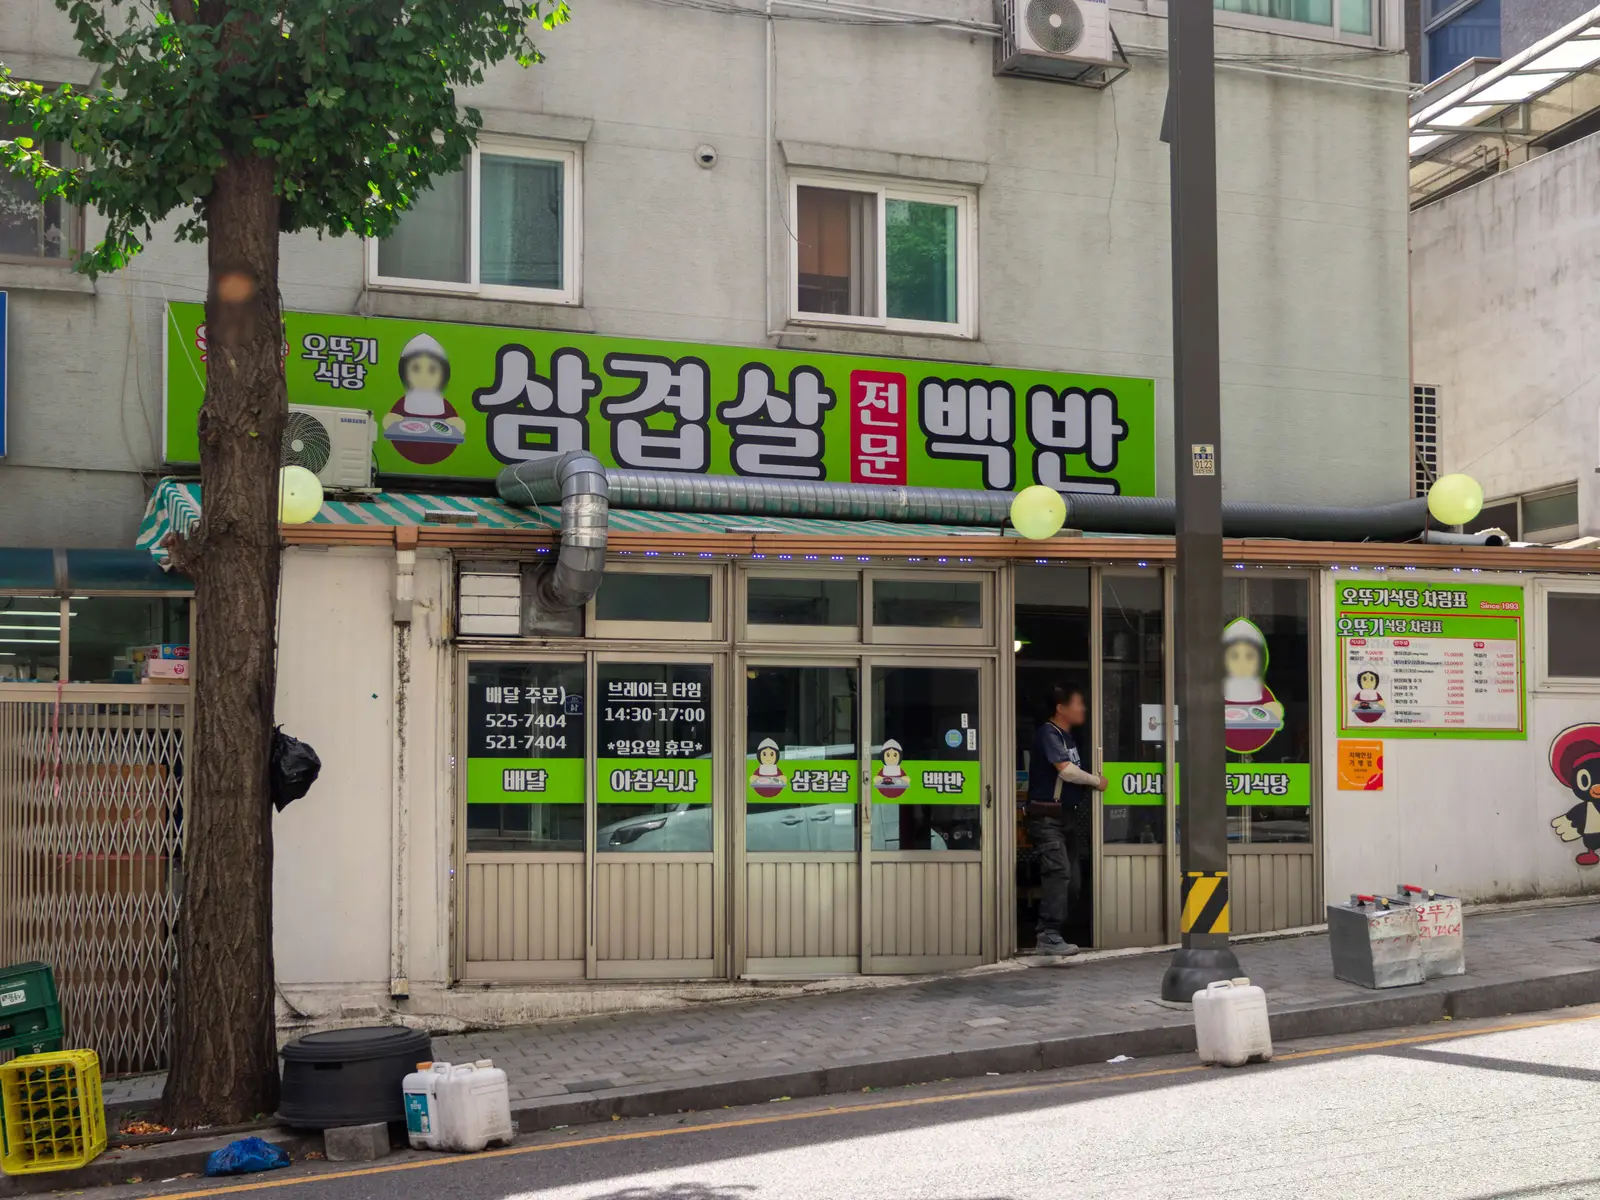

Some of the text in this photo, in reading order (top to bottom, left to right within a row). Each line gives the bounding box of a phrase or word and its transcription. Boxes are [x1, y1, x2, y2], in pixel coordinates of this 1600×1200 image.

[301, 333, 378, 364] 오뚜기
[313, 361, 368, 390] 식당
[472, 343, 837, 481] 삼겹살
[857, 381, 900, 479] 전문
[918, 376, 1129, 496] 백반
[1342, 588, 1468, 608] 오뚜기식당 차림표
[1480, 601, 1519, 610] Since 1993
[1409, 620, 1443, 633] 차림표
[486, 686, 566, 705] 배달 주문)
[608, 682, 702, 698] 브레이크 타임
[485, 713, 567, 728] 525-7404
[604, 707, 706, 722] 14:30-17:00
[485, 735, 567, 749] 521-7404
[503, 768, 548, 792] 배달
[611, 769, 698, 792] 아침식사
[791, 770, 850, 792] 삼겹살
[922, 770, 965, 793] 백반
[1122, 773, 1166, 795] 어서
